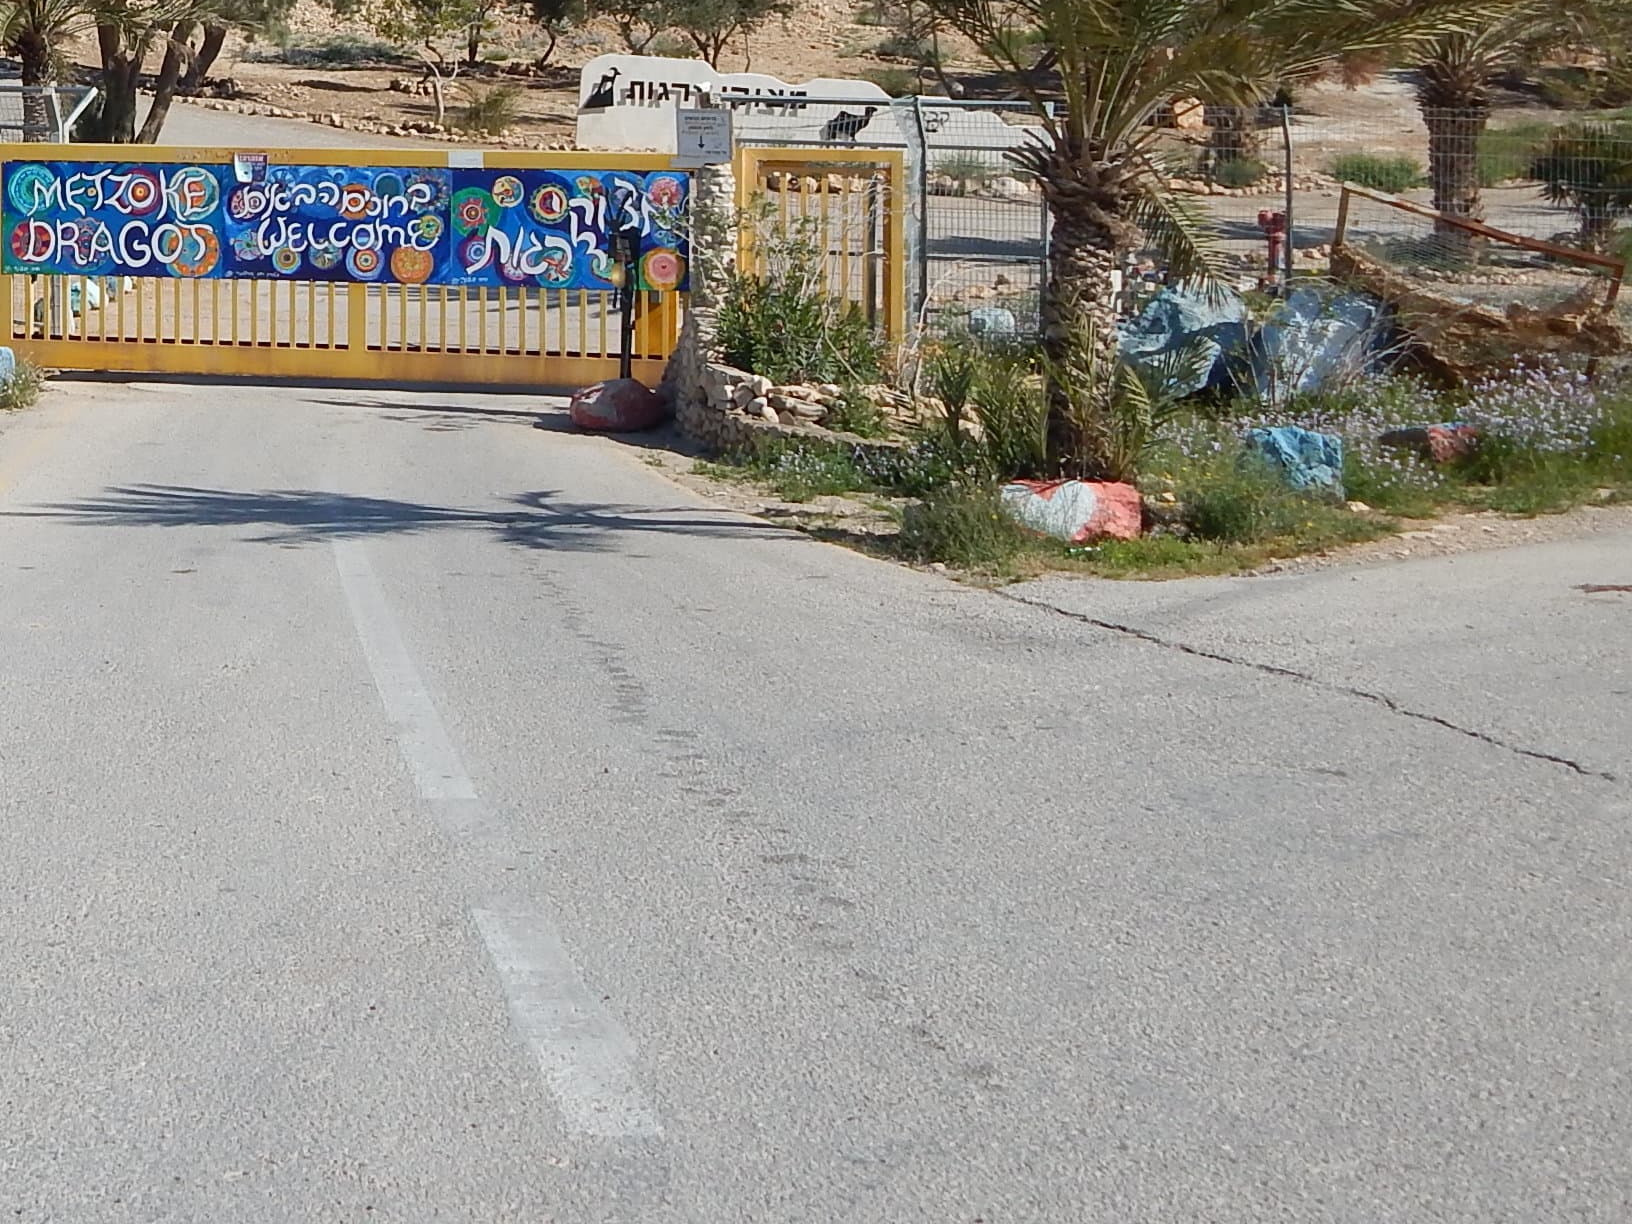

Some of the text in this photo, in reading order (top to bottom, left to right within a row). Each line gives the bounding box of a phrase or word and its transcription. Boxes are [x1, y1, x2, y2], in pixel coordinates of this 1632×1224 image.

[27, 168, 208, 221] METZOKE
[234, 182, 431, 219] ברוכים הבאים
[23, 218, 213, 268] DRAGOT
[257, 214, 440, 256] WELCOME
[465, 226, 607, 275] דרגות
